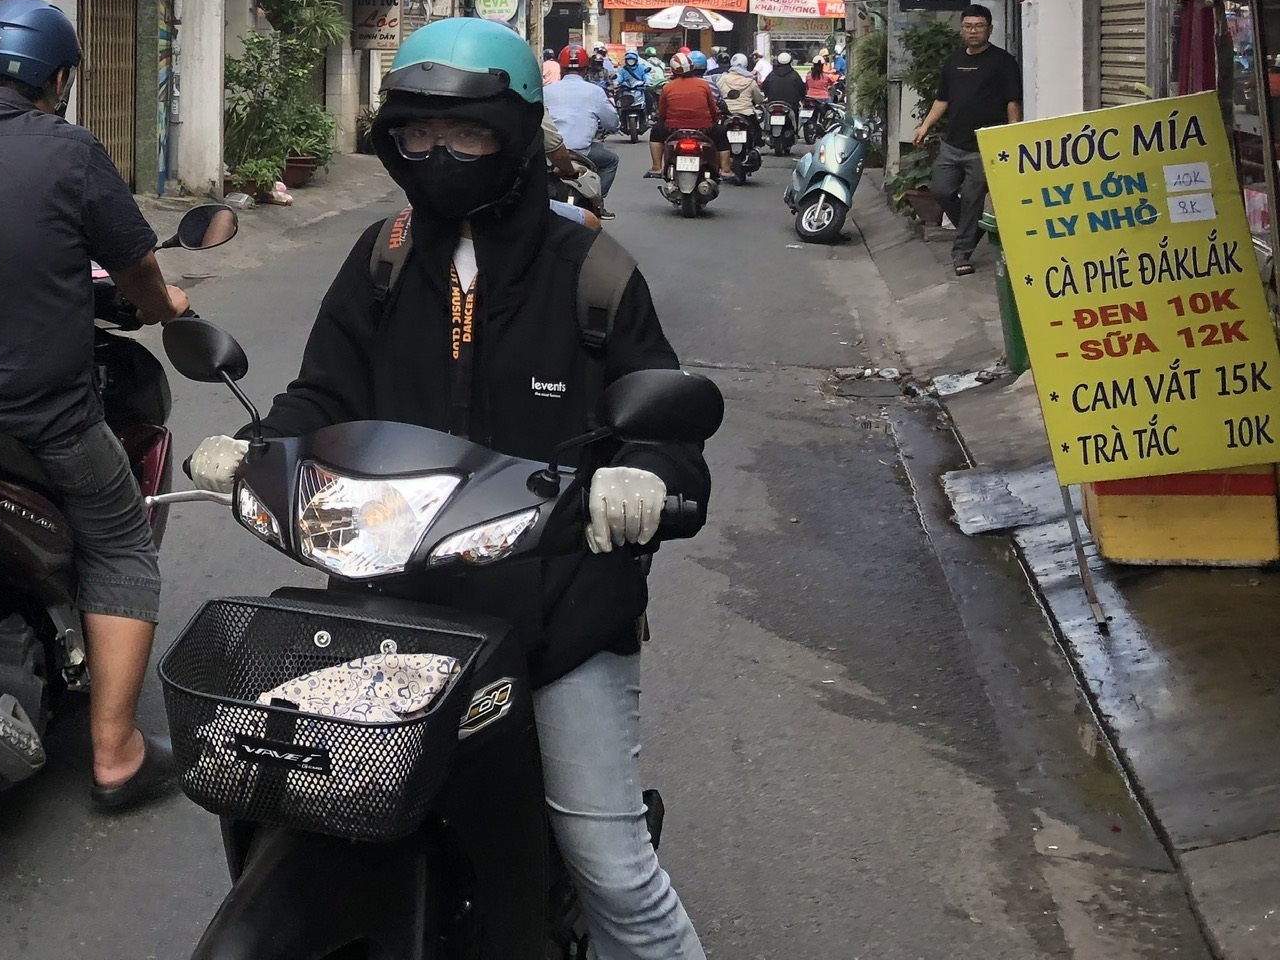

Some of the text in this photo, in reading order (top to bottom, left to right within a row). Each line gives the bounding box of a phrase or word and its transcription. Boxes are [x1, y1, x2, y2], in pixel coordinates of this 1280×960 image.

[379, 32, 396, 41] DÂN
[1017, 110, 1208, 174] NƯỚC MÍA
[1043, 183, 1074, 208] LY
[1085, 171, 1149, 200] LỚN
[1046, 215, 1080, 239] LY
[1088, 199, 1160, 233] NHỎ
[1045, 229, 1243, 298] CÀ PHÊ ĐẮKLẮK
[452, 287, 461, 323] MUSIC
[1072, 288, 1241, 331] ĐEN 10K
[452, 328, 460, 359] CLUB
[1080, 320, 1250, 361] SỮA 12K
[531, 376, 566, 392] levents
[1072, 358, 1272, 413] CAM VẮT 15K
[1077, 414, 1275, 466] TRÀ TẮC 10K
